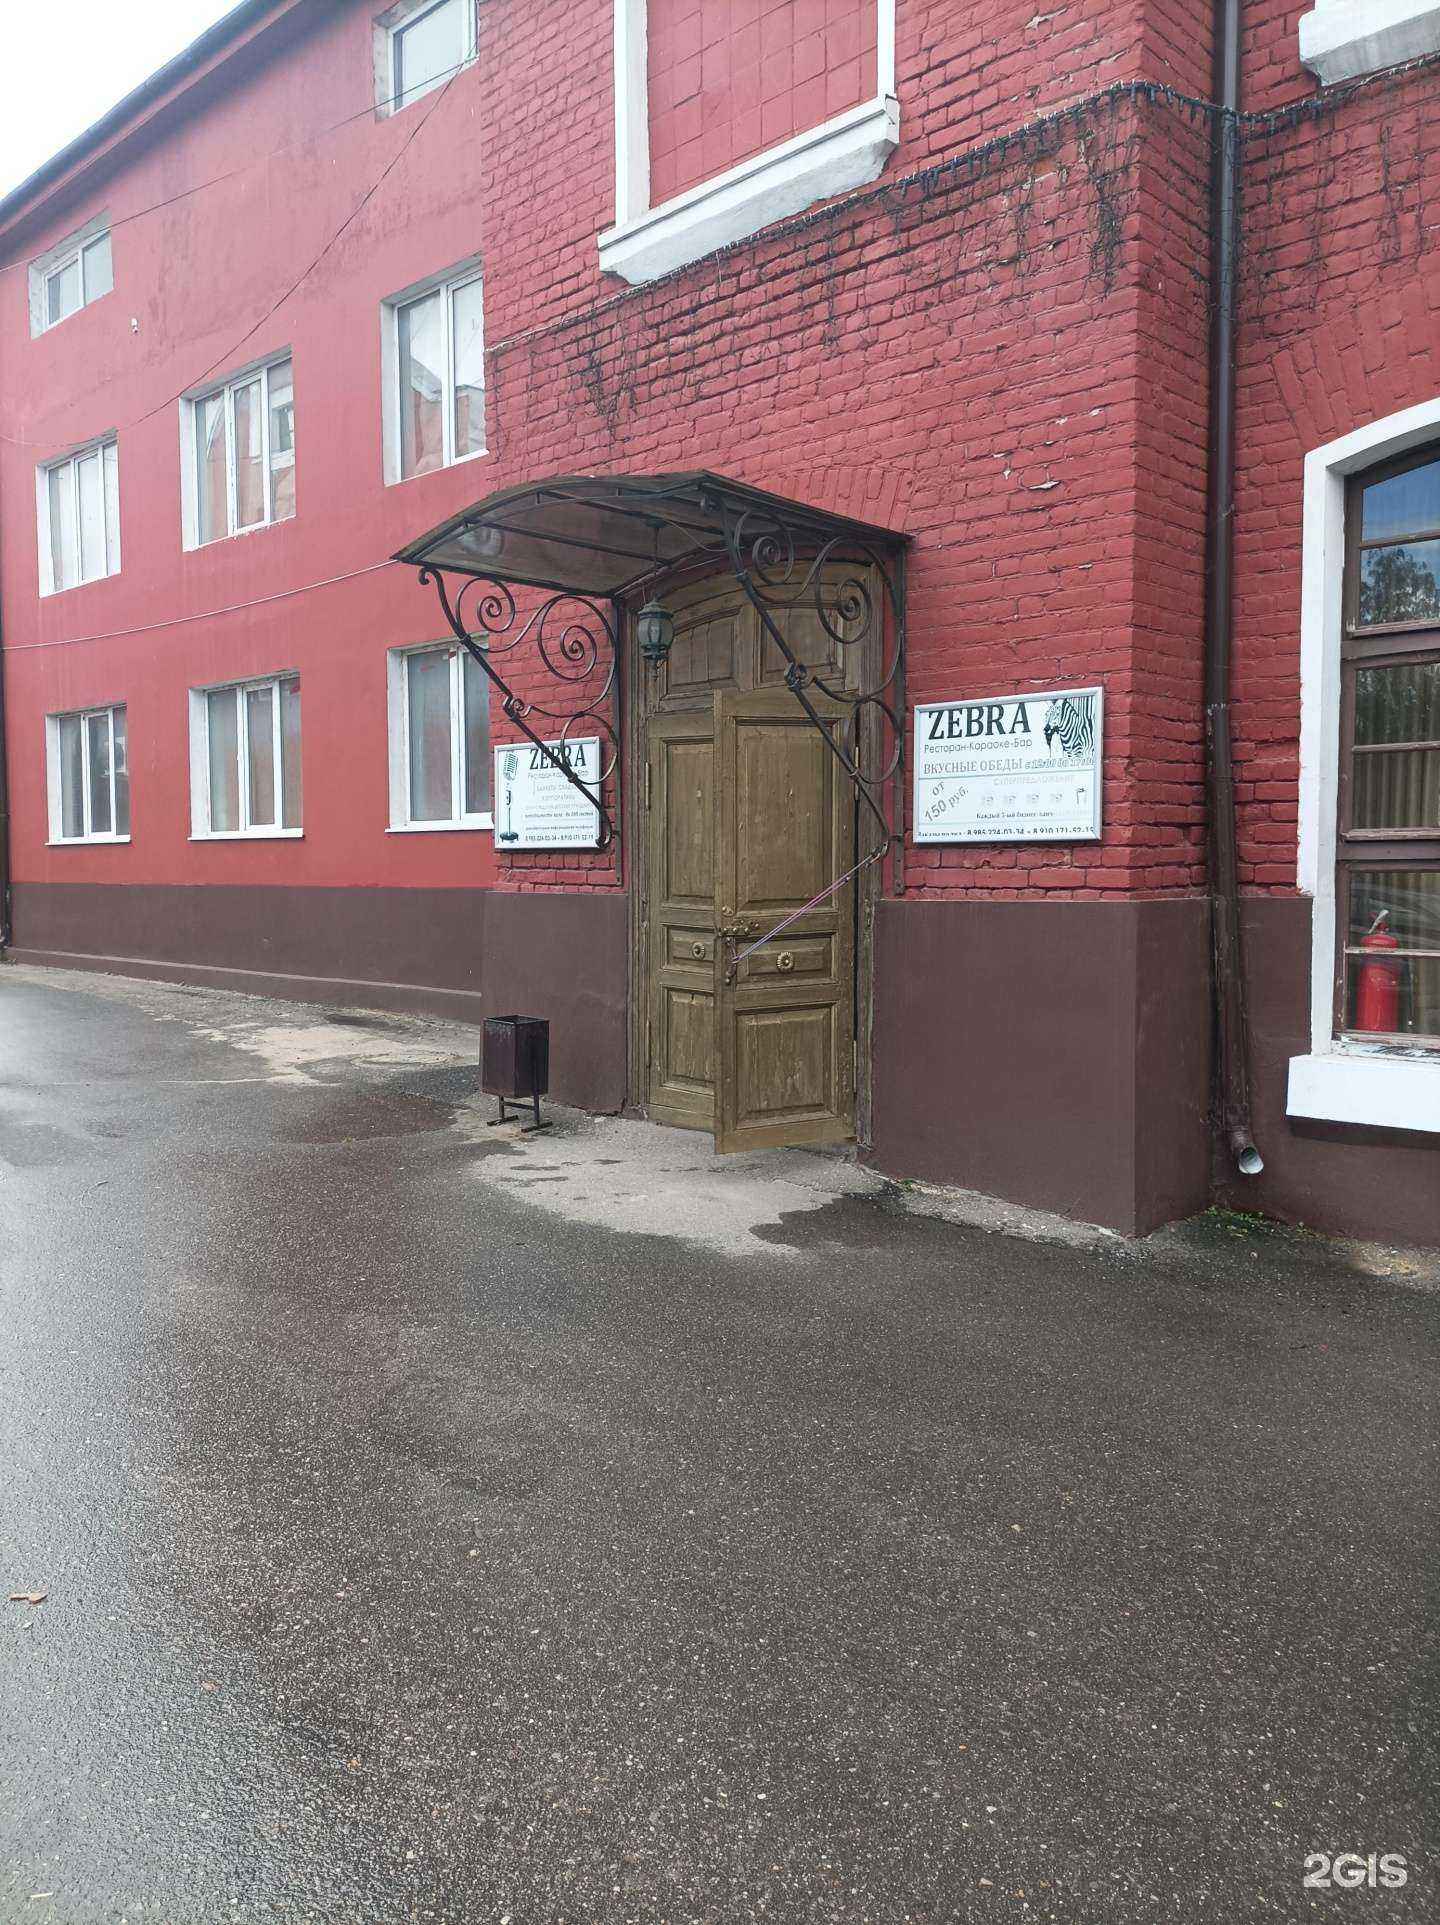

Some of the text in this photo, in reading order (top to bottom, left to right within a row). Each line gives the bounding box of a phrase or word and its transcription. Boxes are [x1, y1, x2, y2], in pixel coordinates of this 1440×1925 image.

[928, 702, 1031, 740] ZEBRA
[924, 737, 1033, 754] Ресторан-Караоке-Бар
[924, 760, 977, 775] ВКУСНЫЕ
[979, 757, 1023, 773] ОБЕДЫ
[925, 799, 947, 822] 150
